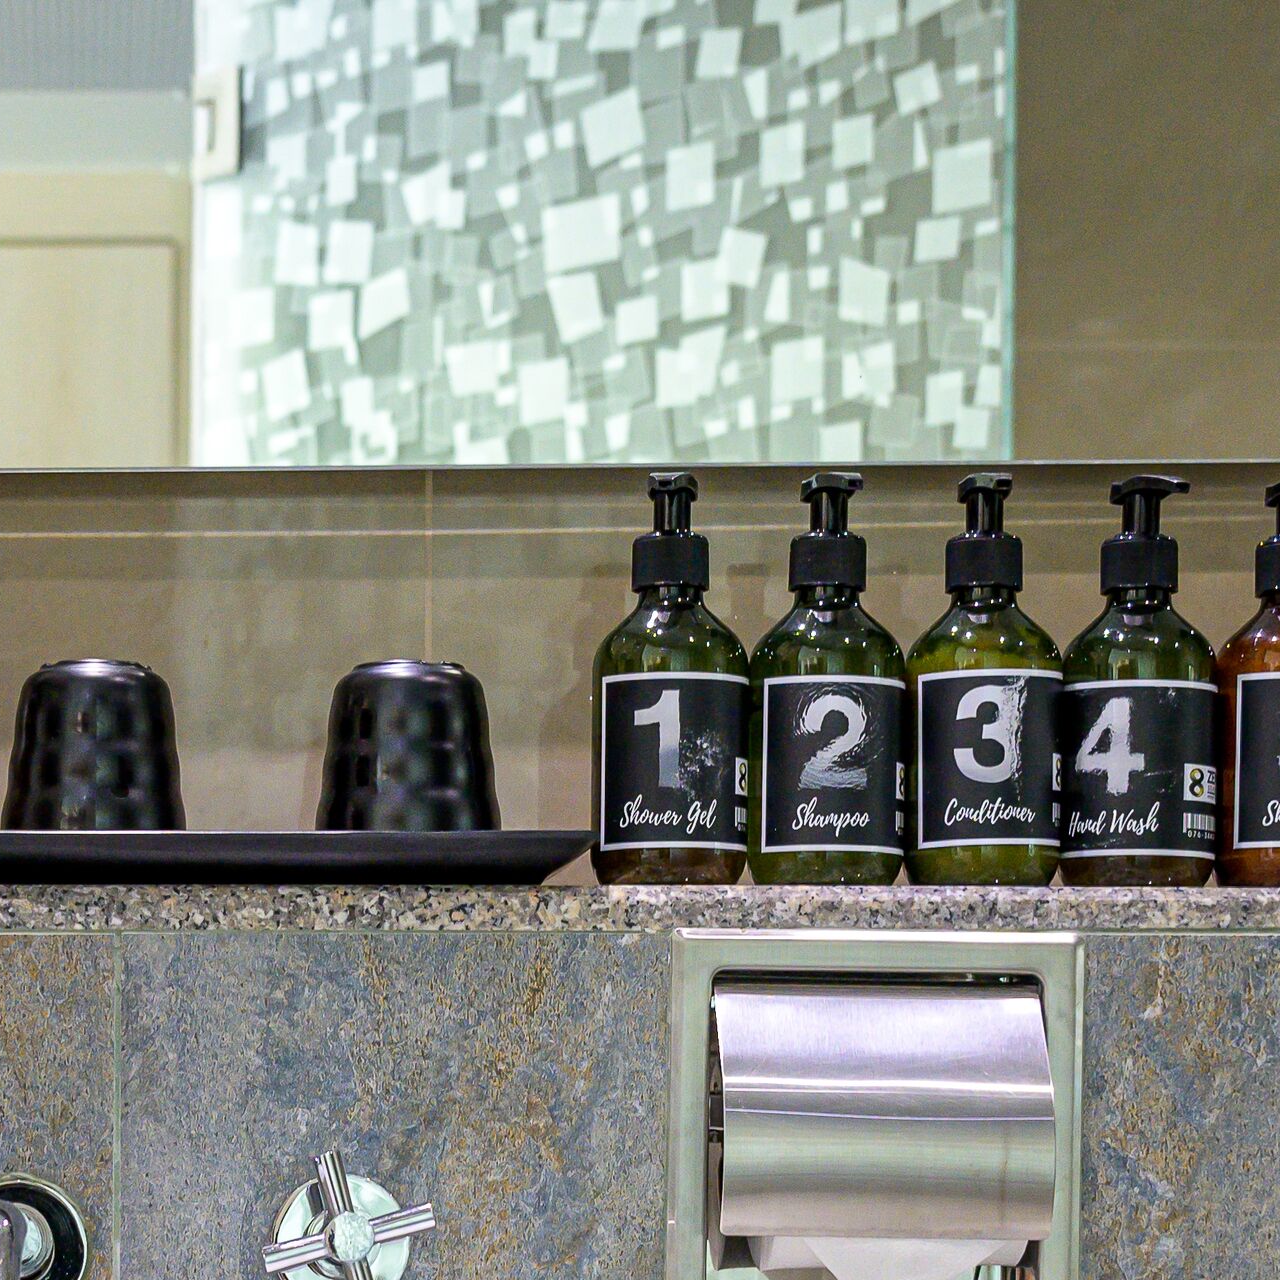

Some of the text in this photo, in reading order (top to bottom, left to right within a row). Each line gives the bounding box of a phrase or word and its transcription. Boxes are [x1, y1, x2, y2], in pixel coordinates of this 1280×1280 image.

[633, 688, 681, 789] 1
[797, 692, 869, 792] 2
[953, 684, 1024, 784] 3
[1075, 696, 1146, 797] 4
[619, 793, 717, 835] Shower Gel
[791, 796, 870, 837] Shampoo
[944, 797, 1036, 827] Conditioner
[1068, 800, 1161, 838] Hand Wash
